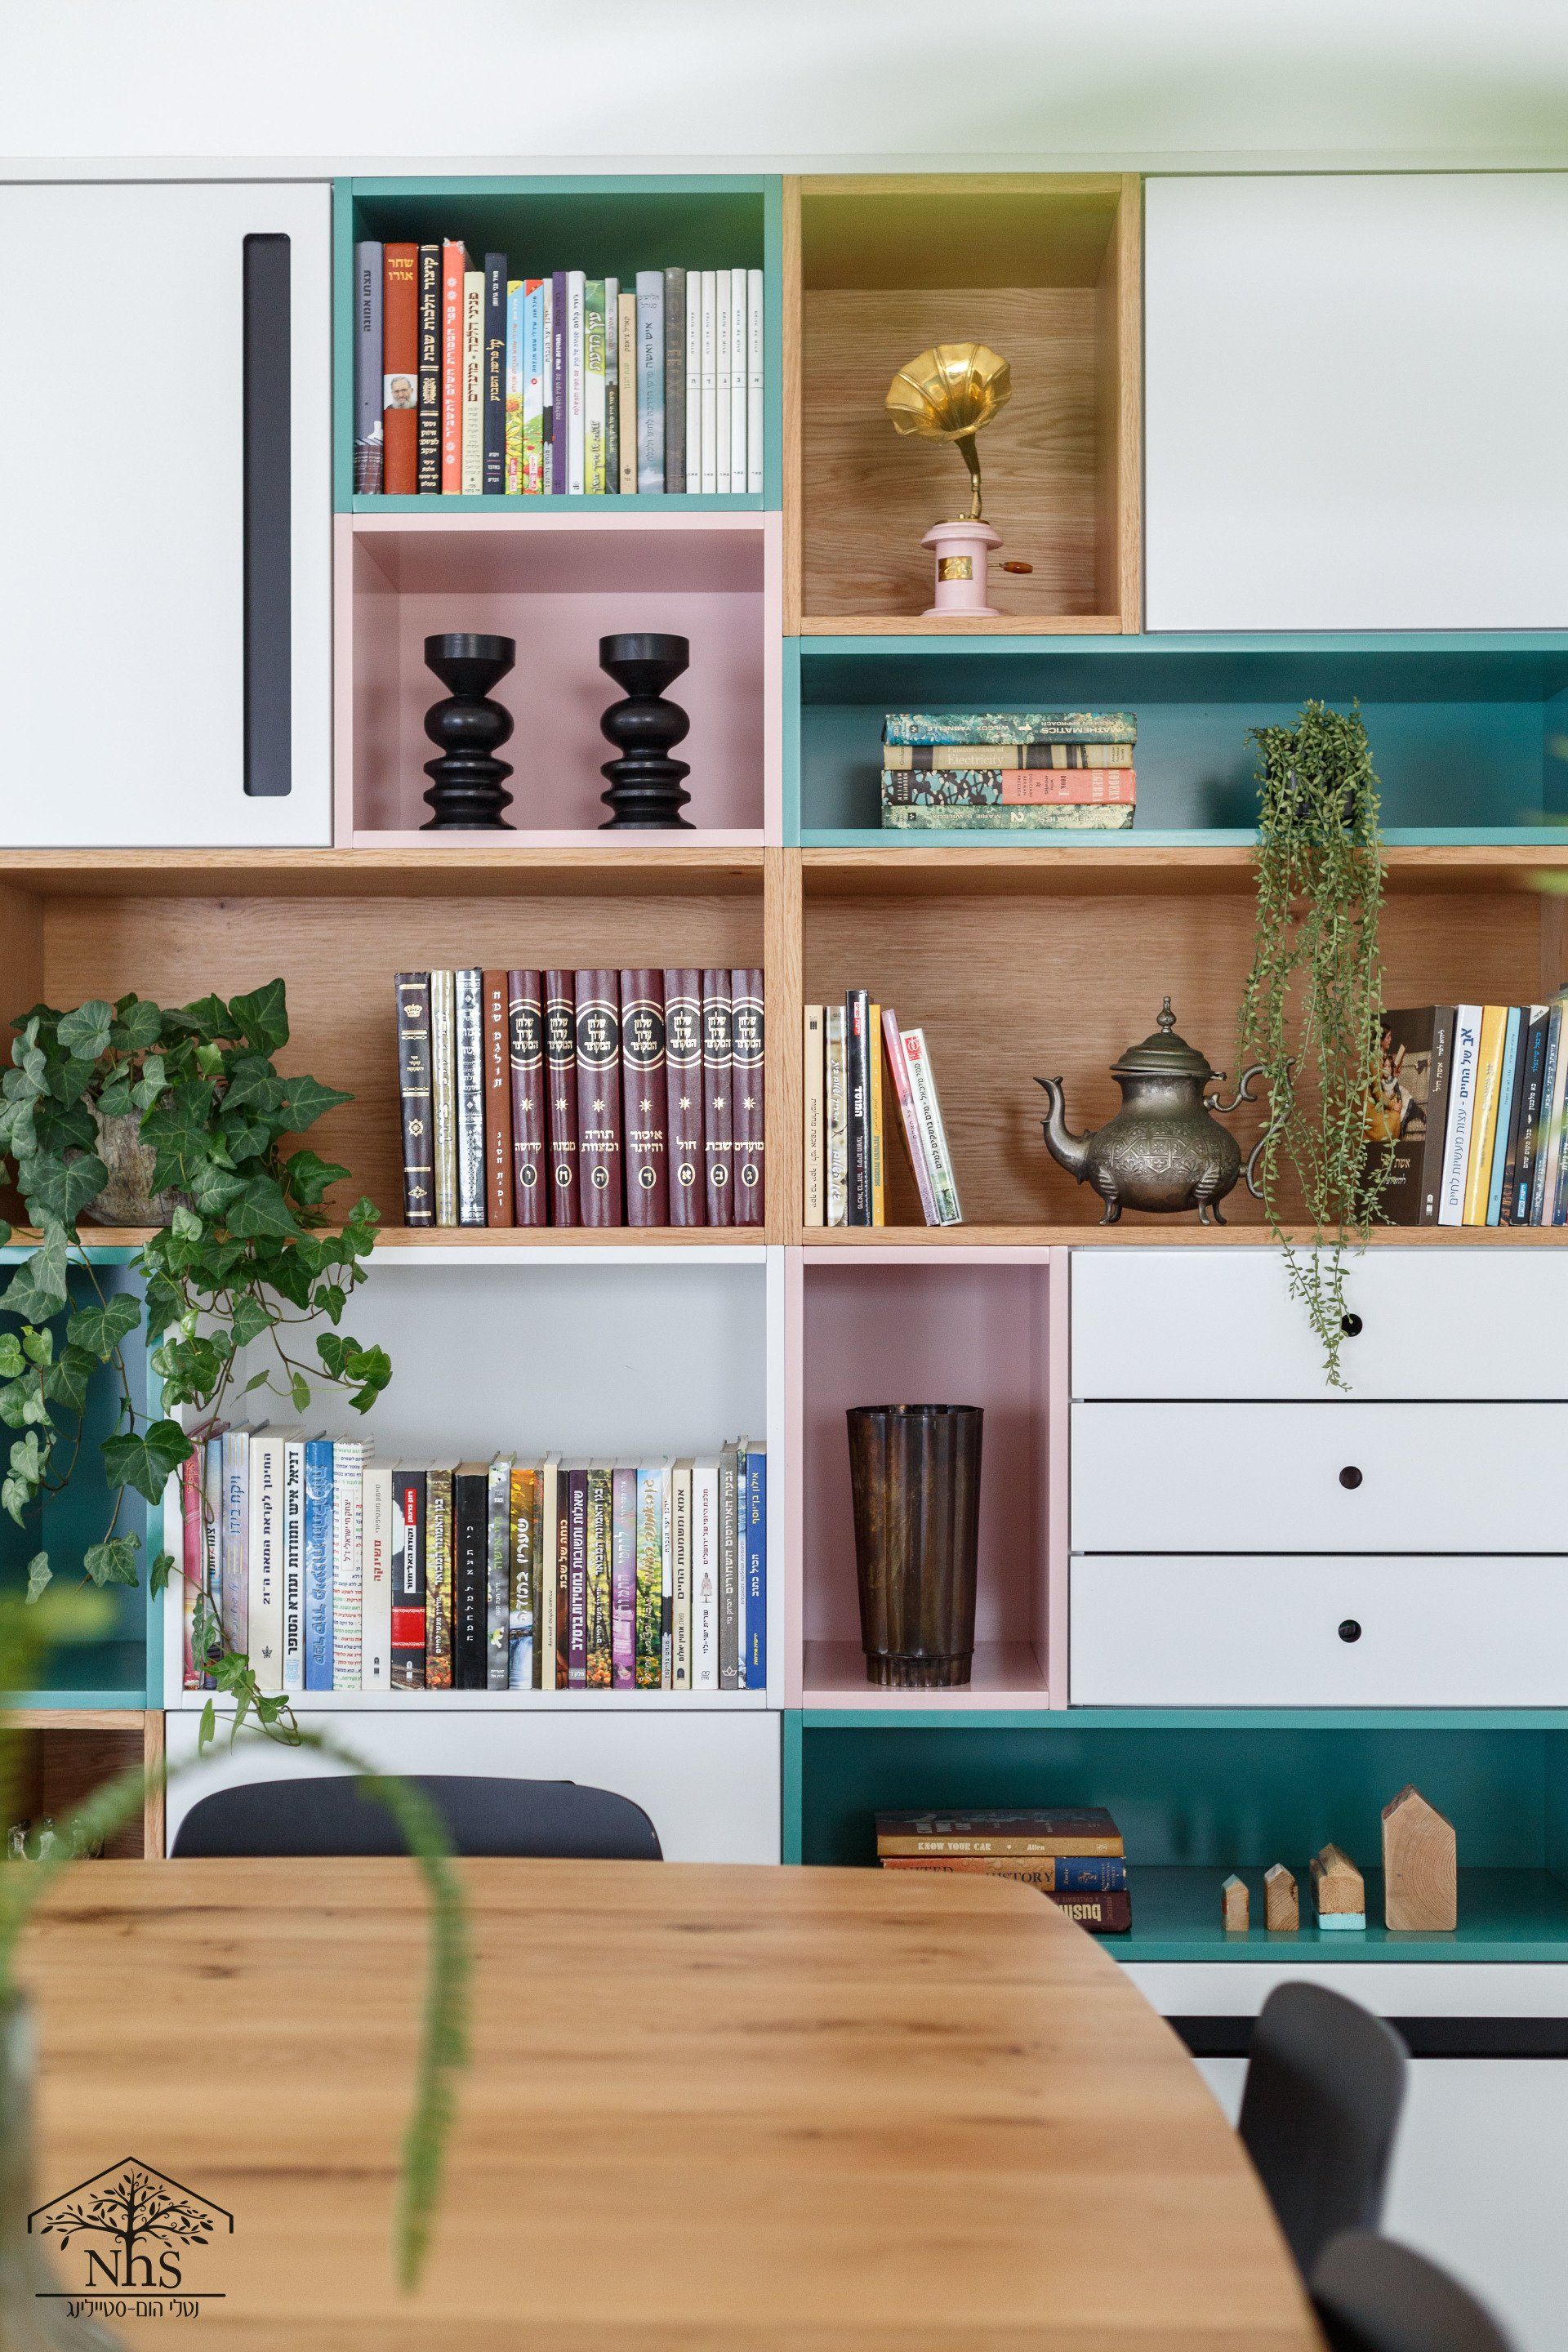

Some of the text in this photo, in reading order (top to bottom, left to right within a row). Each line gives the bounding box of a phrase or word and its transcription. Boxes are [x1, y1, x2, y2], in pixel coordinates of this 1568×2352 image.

[388, 258, 414, 268] שחר
[388, 271, 414, 281] אורו
[420, 256, 439, 362] קיצור הלכות שבת
[468, 292, 479, 318] פניני
[363, 300, 372, 332] אמונה
[447, 306, 455, 325] ספר
[466, 323, 479, 352] הלכה
[588, 311, 605, 371] עץ הדעת
[485, 338, 505, 402] על פרשת השבוע
[467, 363, 479, 401] מועדים
[947, 754, 1004, 765] Electricity
[1010, 811, 1025, 822] 2
[516, 1013, 534, 1031] שלחן
[550, 1013, 568, 1031] שלחן
[587, 1013, 606, 1031] שלחן
[634, 1013, 653, 1032] שלחן
[673, 1011, 693, 1029] שלחן
[708, 1011, 727, 1029] שלחן
[738, 1011, 757, 1029] שלחן
[516, 1029, 533, 1042] ערוך
[550, 1029, 568, 1042] ערוך
[588, 1029, 606, 1042] ערוך
[635, 1029, 653, 1043] ערוך
[674, 1027, 693, 1040] ערוך
[708, 1027, 727, 1040] ערוך
[739, 1027, 757, 1040] ערוך
[512, 1040, 539, 1054] המקוצר
[546, 1040, 573, 1054] המקוצר
[584, 1040, 611, 1054] המקוצר
[630, 1040, 657, 1054] המקוצר
[670, 1038, 697, 1052] המקוצר
[704, 1038, 732, 1052] המקוצר
[734, 1038, 762, 1052] המקוצר
[914, 1063, 922, 1077] סמי
[1432, 1062, 1443, 1093] אשת חיל
[917, 1078, 928, 1101] מיכאל
[853, 1085, 864, 1117] המוסד
[1449, 1028, 1473, 1205] אב של החיים עצות מעשיות לחיים
[585, 1129, 614, 1140] תורה
[630, 1129, 663, 1141] איסור
[675, 1135, 697, 1151] חול
[923, 1106, 942, 1169] מים נושקים למים
[514, 1142, 541, 1154] קדושה
[581, 1142, 619, 1152] ומצוות
[630, 1143, 663, 1153] והיתר
[705, 1141, 733, 1152] שבת
[734, 1141, 764, 1154] מועדים
[1393, 1157, 1411, 1169] אשת
[559, 1170, 568, 1181] ח
[595, 1172, 604, 1183] ה
[643, 1172, 652, 1183] ד
[682, 1169, 692, 1180] א
[715, 1170, 724, 1181] ב
[262, 1453, 273, 1491] החינוך
[229, 1476, 245, 1535] ויקח בידו
[701, 1488, 709, 1507] מלכת
[261, 1494, 273, 1535] לקראת
[344, 1499, 352, 1517] יצחק
[343, 1526, 352, 1549] ישראלי
[593, 1488, 604, 1576] בגן האמונה המבואר
[701, 1526, 709, 1536] של
[724, 1470, 734, 1594] גבעת האיריסים השחורים
[434, 1499, 445, 1586] בגן האמונה המבואר
[676, 1516, 684, 1566] ומשמעות
[262, 1539, 271, 1574] המאה
[287, 1451, 299, 1655] דניאל איש חמודות ועזרא הסופר
[343, 1551, 352, 1561] ז"ל
[558, 1519, 568, 1589] כוחה של שבת
[701, 1537, 709, 1565] ירושלים
[570, 1490, 584, 1650] שאלות ותשובות בחסידות ברסלב
[749, 1554, 760, 1597] הכול כתוב
[465, 1526, 474, 1642] כי תצא למלחמה
[676, 1568, 684, 1600] החיים
[918, 1842, 991, 1851] KNOW YOUR CAR
[1027, 1843, 1045, 1851] Allen
